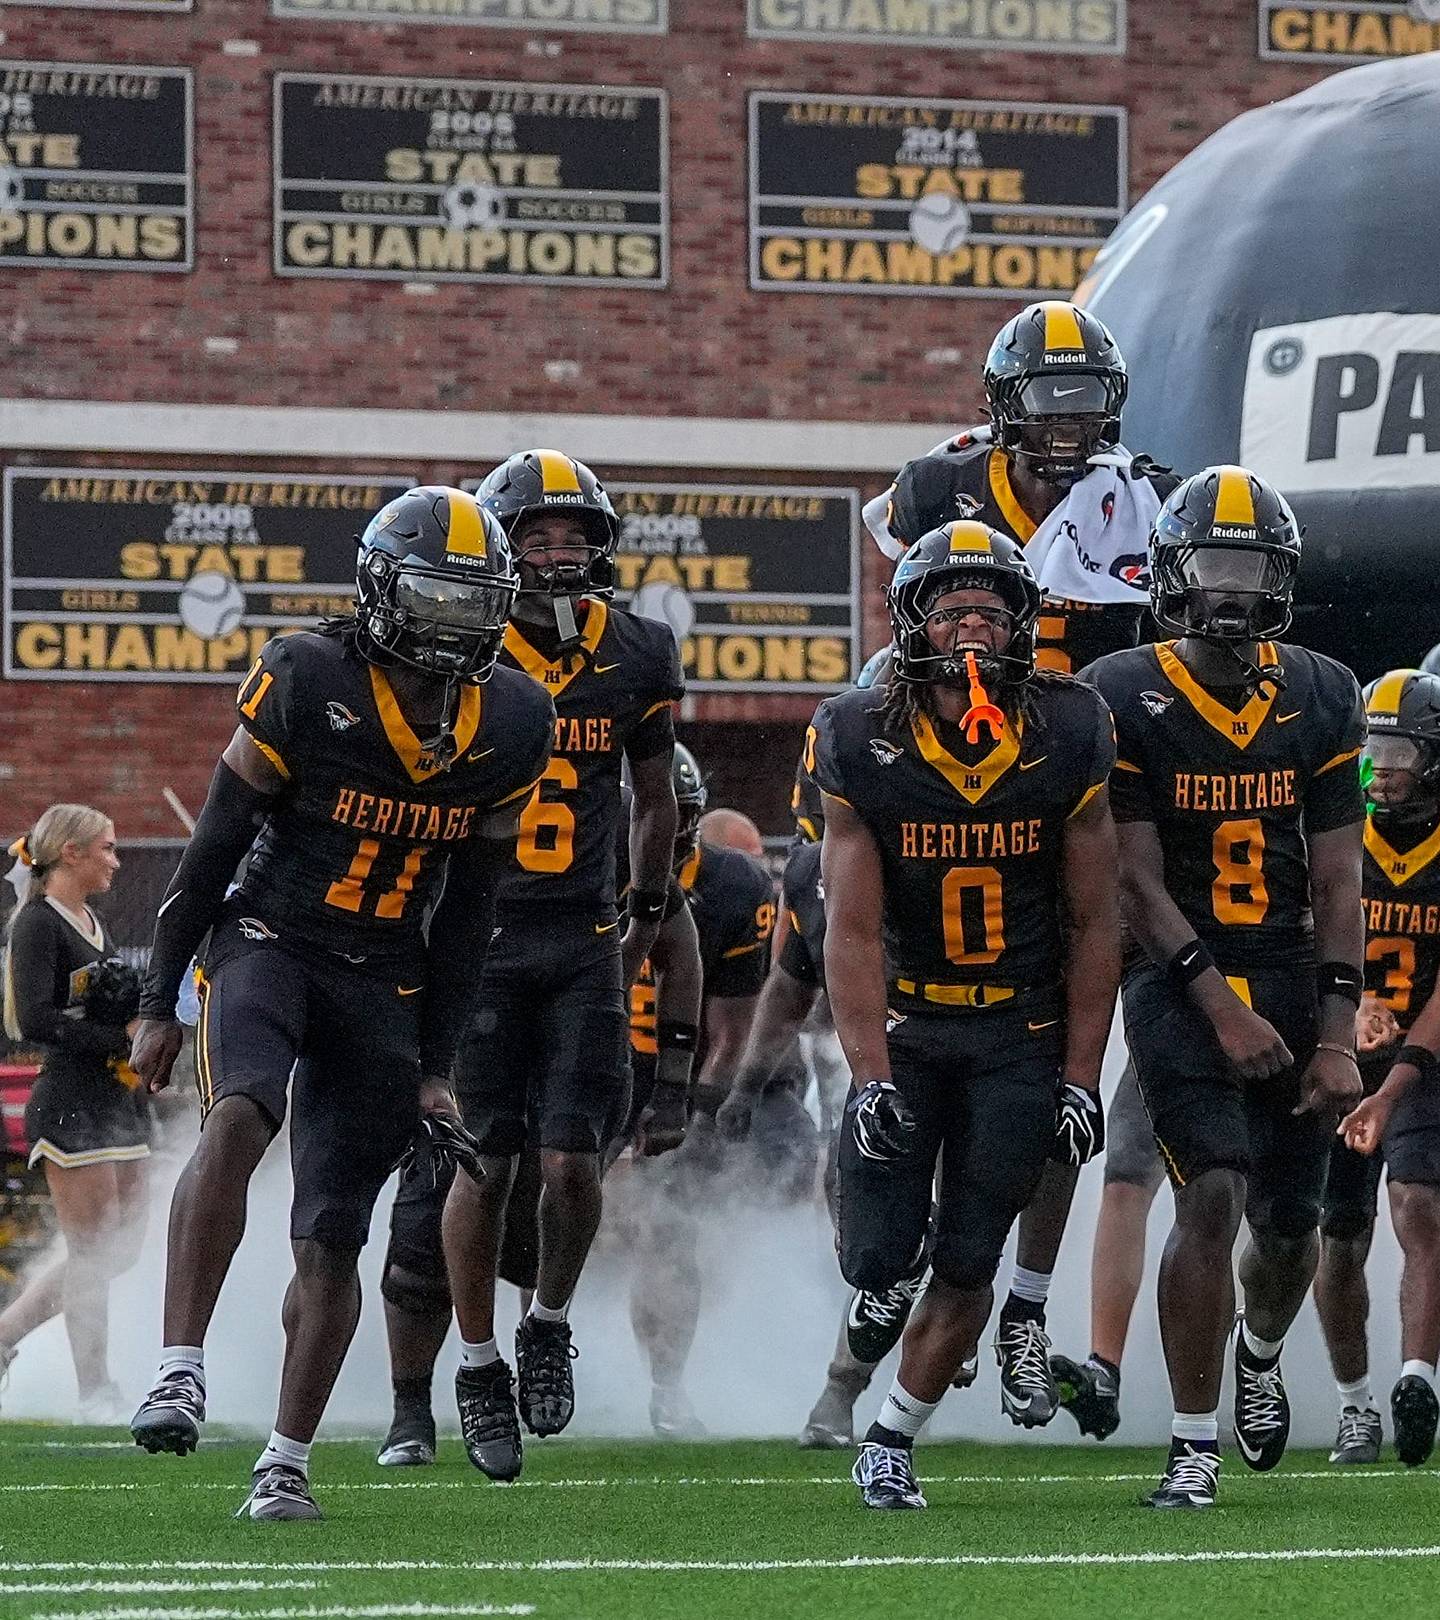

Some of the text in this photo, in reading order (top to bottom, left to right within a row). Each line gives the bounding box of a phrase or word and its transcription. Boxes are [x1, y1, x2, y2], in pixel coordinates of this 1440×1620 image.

[313, 83, 640, 120] AMERICAN HERITAGE
[385, 148, 562, 187] STATE
[855, 163, 1025, 203] STATE
[286, 223, 658, 278] CHAMPIONS
[1044, 353, 1087, 364] Riddell
[42, 478, 383, 511] AMERICAN HERITAGE
[543, 494, 585, 505] Riddell
[1212, 526, 1257, 540] Riddell
[119, 541, 306, 583] STATE
[949, 554, 995, 565] Riddell
[1174, 769, 1297, 812] HERITAGE
[331, 787, 477, 842] HERITAGE
[515, 756, 579, 875] 6
[901, 818, 1042, 859] HERITAGE
[323, 838, 434, 919] 11
[1211, 817, 1270, 926] 8
[940, 866, 1006, 966] 0
